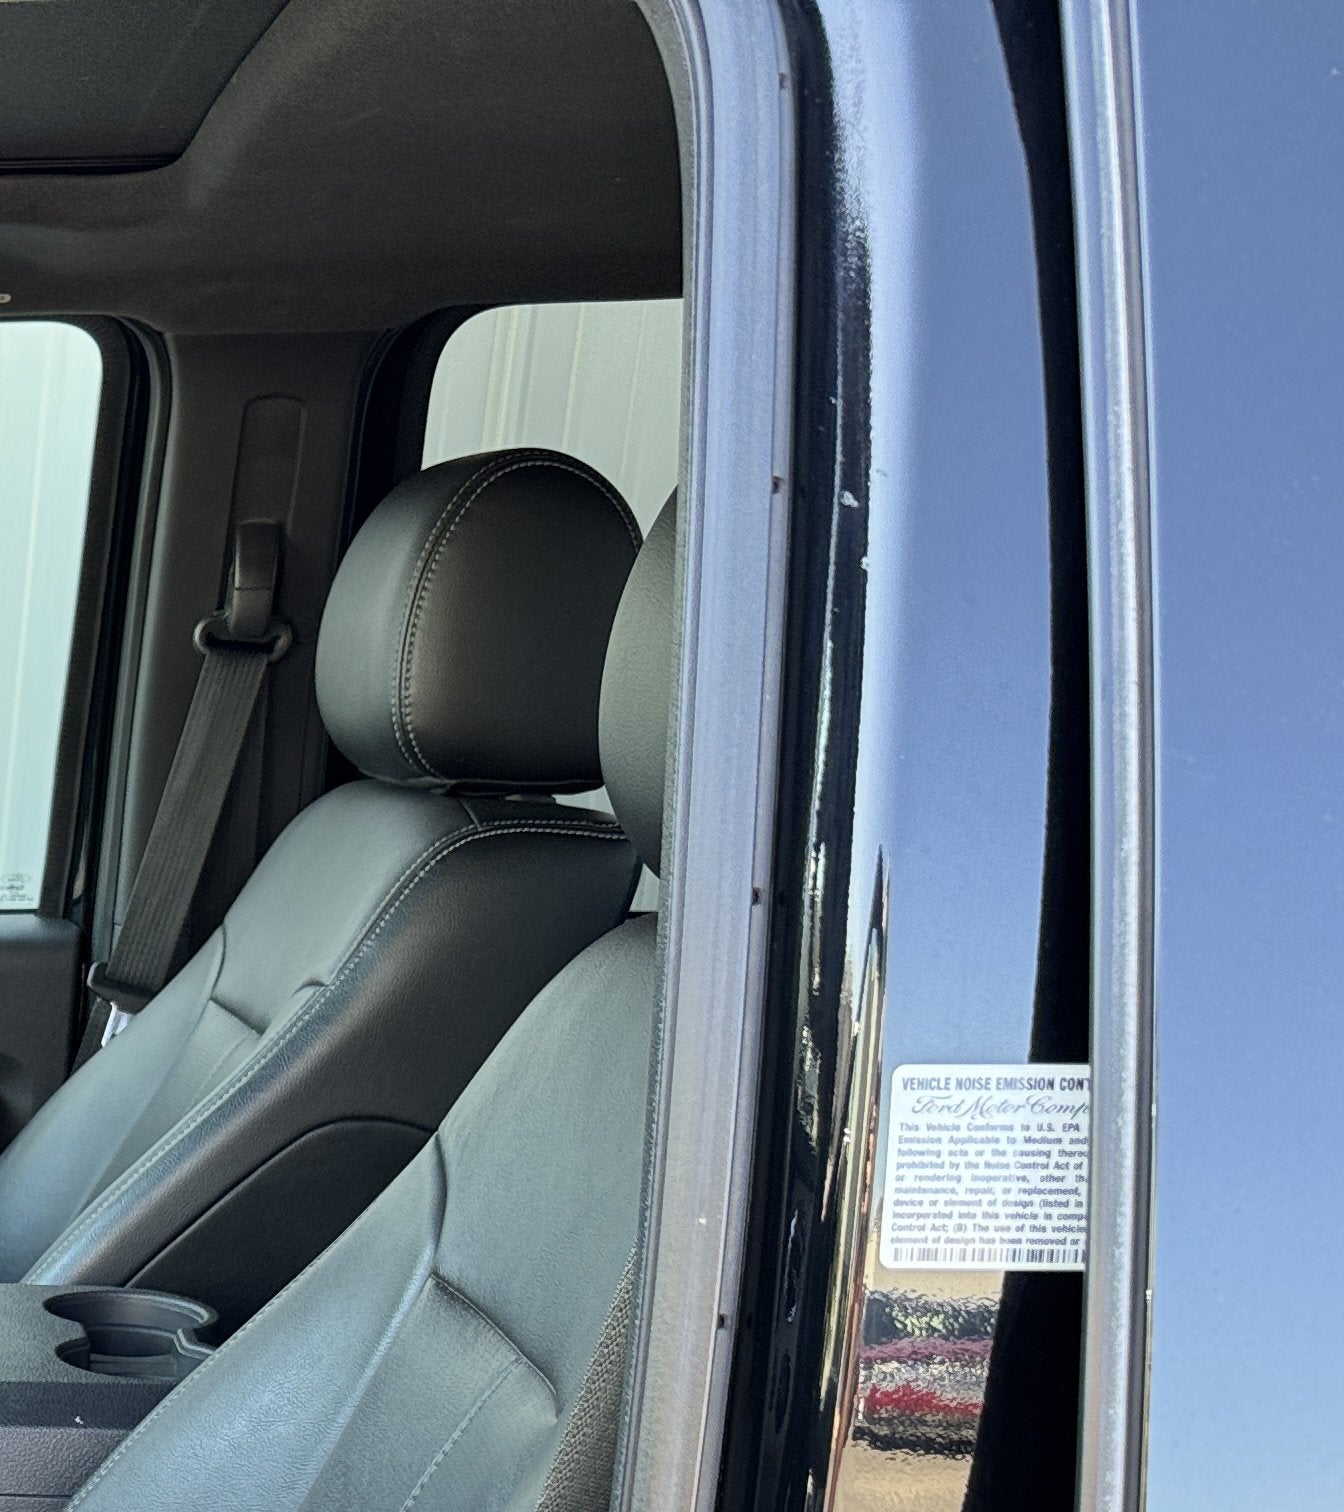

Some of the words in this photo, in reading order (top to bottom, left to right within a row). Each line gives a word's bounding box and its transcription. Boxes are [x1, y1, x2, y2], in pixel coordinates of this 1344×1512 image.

[902, 1077, 951, 1091] VEHICLE
[955, 1077, 992, 1091] NOISE
[995, 1077, 1055, 1091] EMISSION
[912, 1095, 966, 1114] Ford
[954, 1095, 1026, 1120] Motor
[900, 1122, 919, 1132] This
[926, 1122, 960, 1132] Vehicle
[967, 1122, 1014, 1132] Conforms
[1020, 1122, 1030, 1132] to
[1036, 1122, 1055, 1132] U.S.
[1062, 1122, 1080, 1132] EPA
[898, 1135, 942, 1144] Emission
[948, 1135, 1000, 1146] Applicable
[1007, 1136, 1016, 1144] to
[1023, 1136, 1063, 1144] Medium
[897, 1148, 941, 1158] following
[991, 1148, 1007, 1157] the
[1013, 1148, 1051, 1159] causing
[896, 1160, 945, 1171] prohibited
[949, 1160, 960, 1171] by
[964, 1161, 979, 1169] the
[984, 1160, 1010, 1169] Noise
[1015, 1161, 1049, 1170] Control
[1053, 1161, 1070, 1170] Act
[1073, 1161, 1083, 1170] of
[895, 1174, 906, 1182] or
[914, 1173, 961, 1184] rendering
[1039, 1174, 1066, 1183] other
[1002, 1187, 1012, 1195] or
[893, 1198, 924, 1207] device
[928, 1199, 939, 1207] or
[944, 1198, 982, 1207] element
[987, 1198, 997, 1207] of
[1002, 1199, 1034, 1209] design
[1039, 1199, 1069, 1209] (listed
[1074, 1199, 1084, 1208] in
[958, 1211, 977, 1219] into
[982, 1211, 999, 1219] this
[1004, 1212, 1039, 1220] vehicle
[891, 1223, 926, 1232] Control
[972, 1223, 990, 1232] The
[1015, 1223, 1025, 1232] of
[1029, 1224, 1047, 1233] this
[932, 1236, 941, 1244] of
[944, 1236, 976, 1246] design
[979, 1236, 996, 1244] has
[1000, 1236, 1022, 1245] been
[1026, 1237, 1067, 1245] removed
